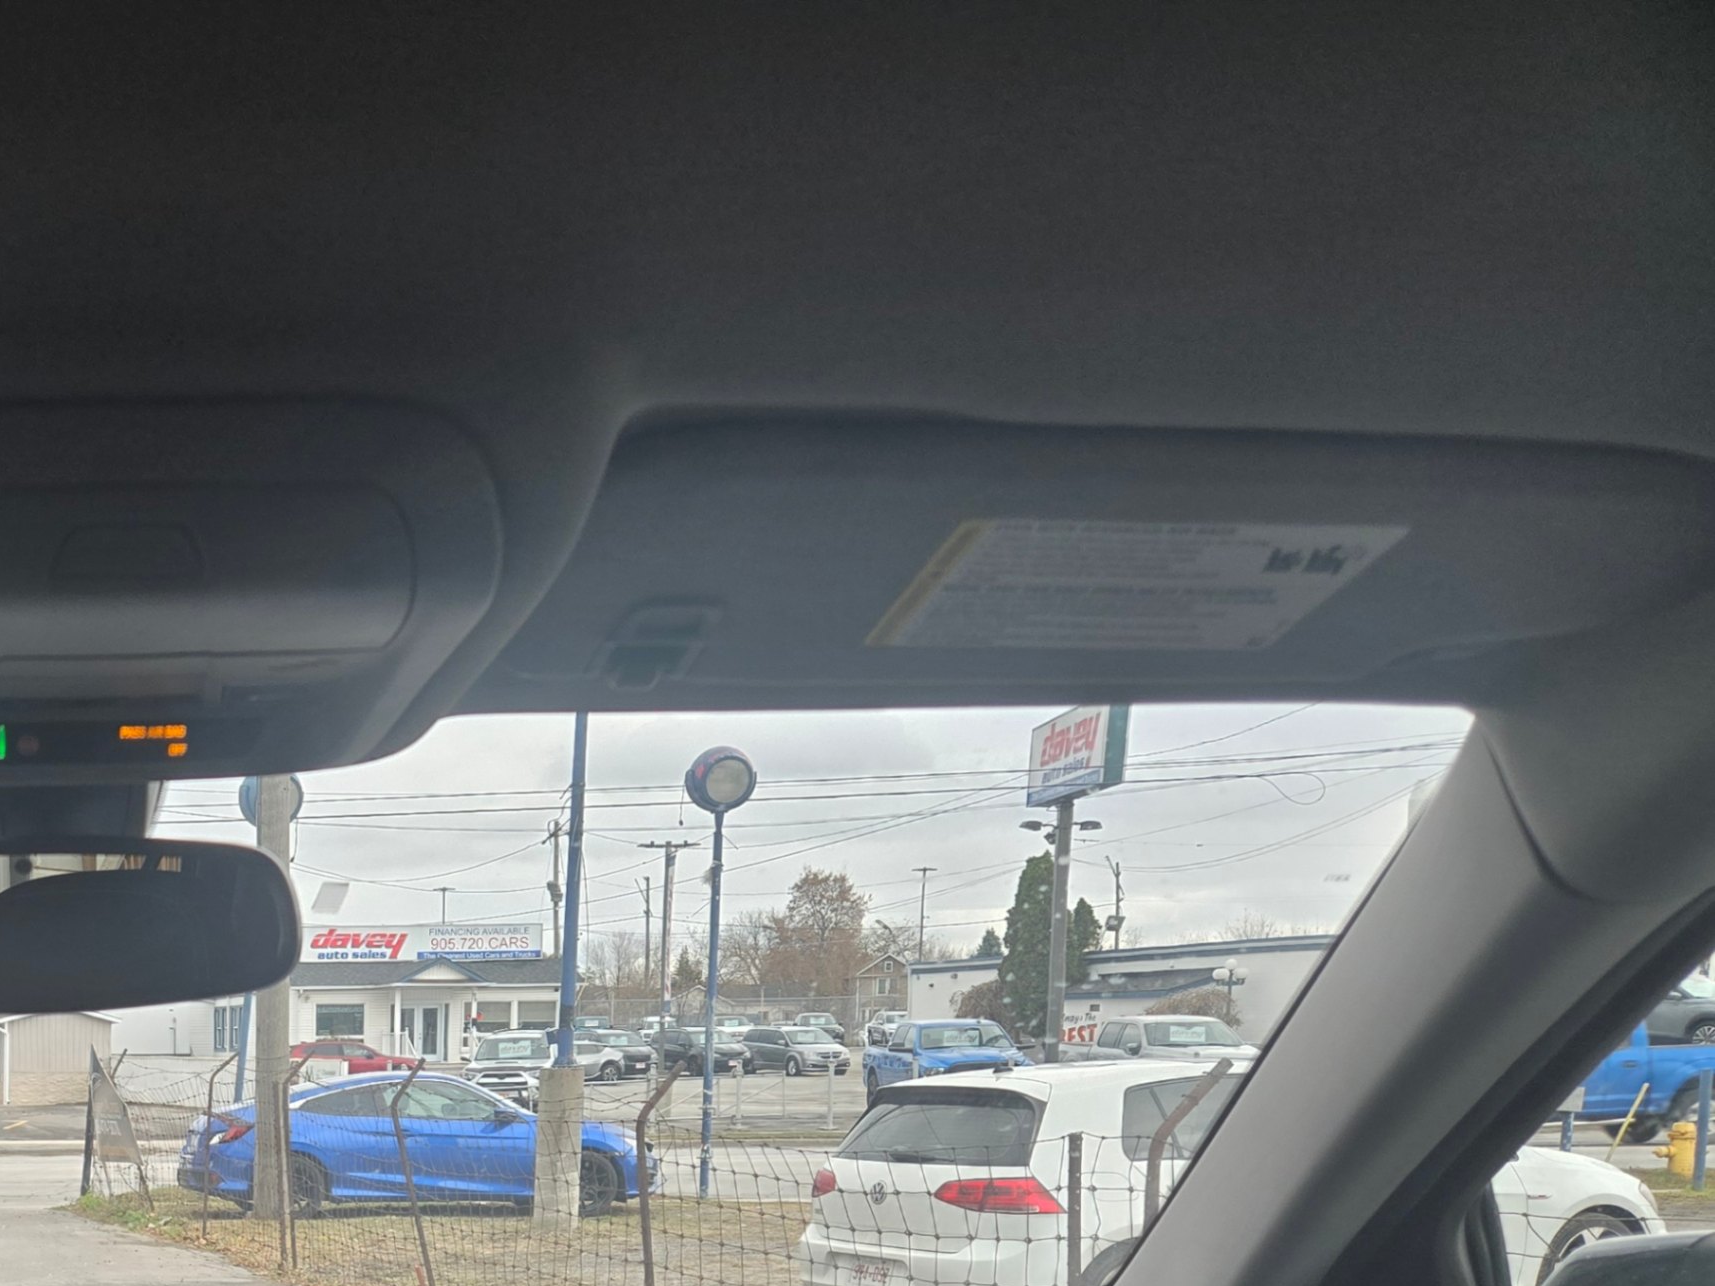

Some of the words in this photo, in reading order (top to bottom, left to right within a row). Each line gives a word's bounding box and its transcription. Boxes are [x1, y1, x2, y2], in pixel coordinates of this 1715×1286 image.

[168, 742, 188, 757] OFF
[429, 928, 479, 936] FINANCING
[482, 927, 530, 936] AVAILABLE
[310, 929, 408, 960] davey
[430, 937, 530, 950] 905.720.CARS
[317, 951, 347, 960] auto
[352, 950, 387, 959] sales
